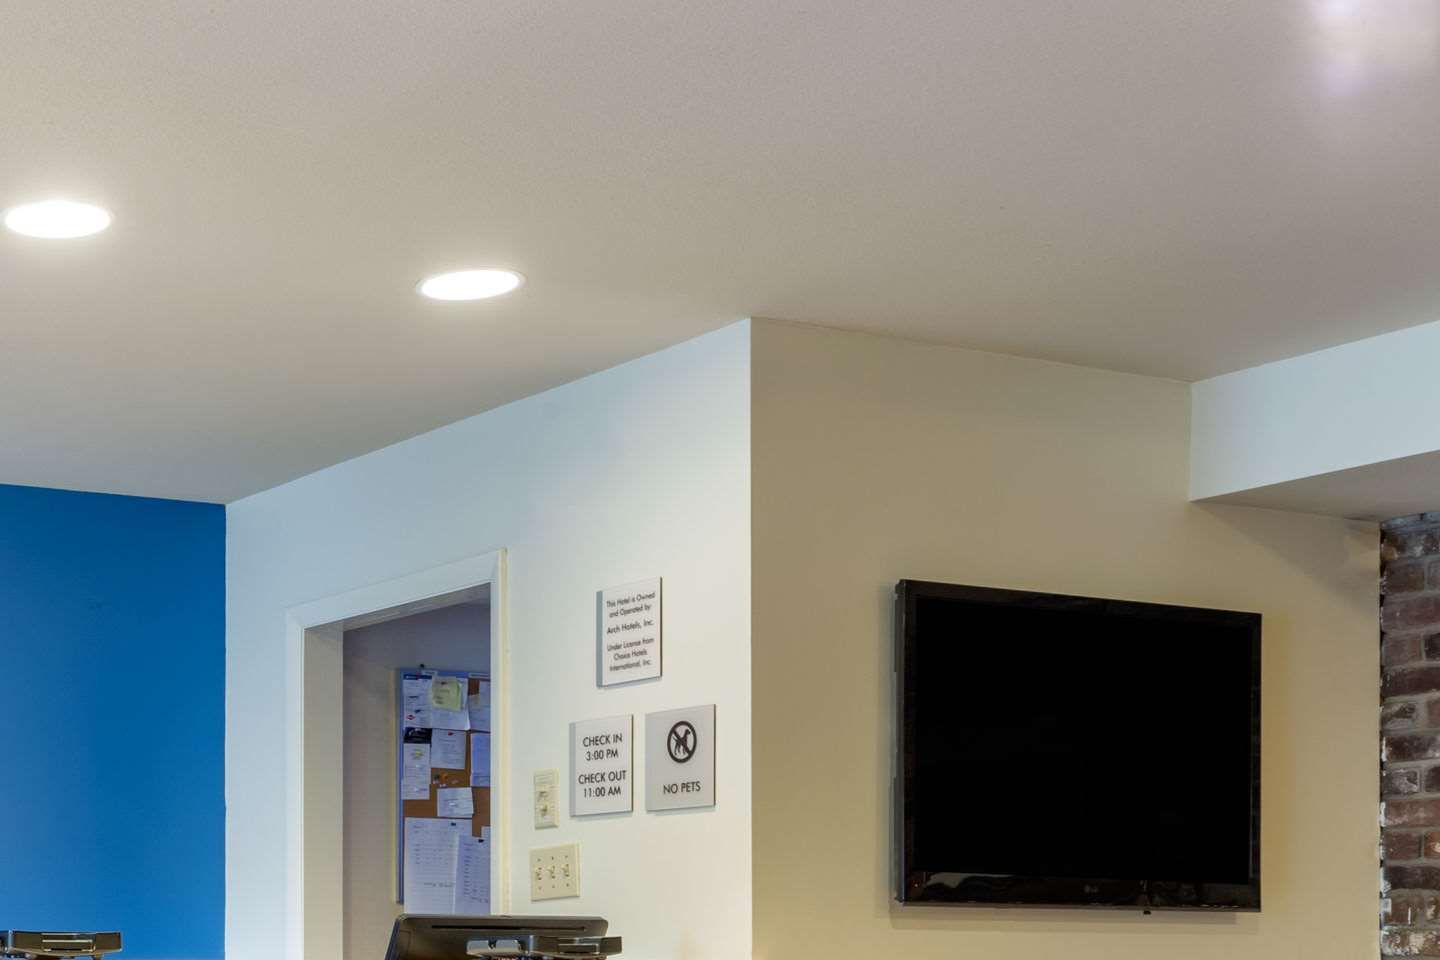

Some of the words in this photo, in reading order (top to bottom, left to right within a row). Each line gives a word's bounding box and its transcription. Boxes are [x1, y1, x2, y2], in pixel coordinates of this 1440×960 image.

[617, 596, 631, 606] Hotel
[636, 592, 656, 602] Owned
[609, 609, 619, 618] and
[620, 604, 643, 616] Operated
[644, 602, 651, 612] by
[606, 625, 621, 635] Arch
[607, 642, 622, 652] Under
[623, 640, 641, 649] License
[642, 636, 654, 645] from
[613, 652, 631, 661] Choice
[632, 649, 648, 657] Hotels
[582, 734, 610, 748] CHECK
[613, 733, 623, 743] IN
[586, 750, 605, 761] 3:00
[606, 748, 619, 759] PM
[578, 772, 606, 784] CHECK
[608, 770, 627, 782] OUT
[583, 787, 606, 798] 11:00
[608, 785, 621, 796] AM
[663, 783, 679, 795] NO
[681, 780, 701, 793] PETS
